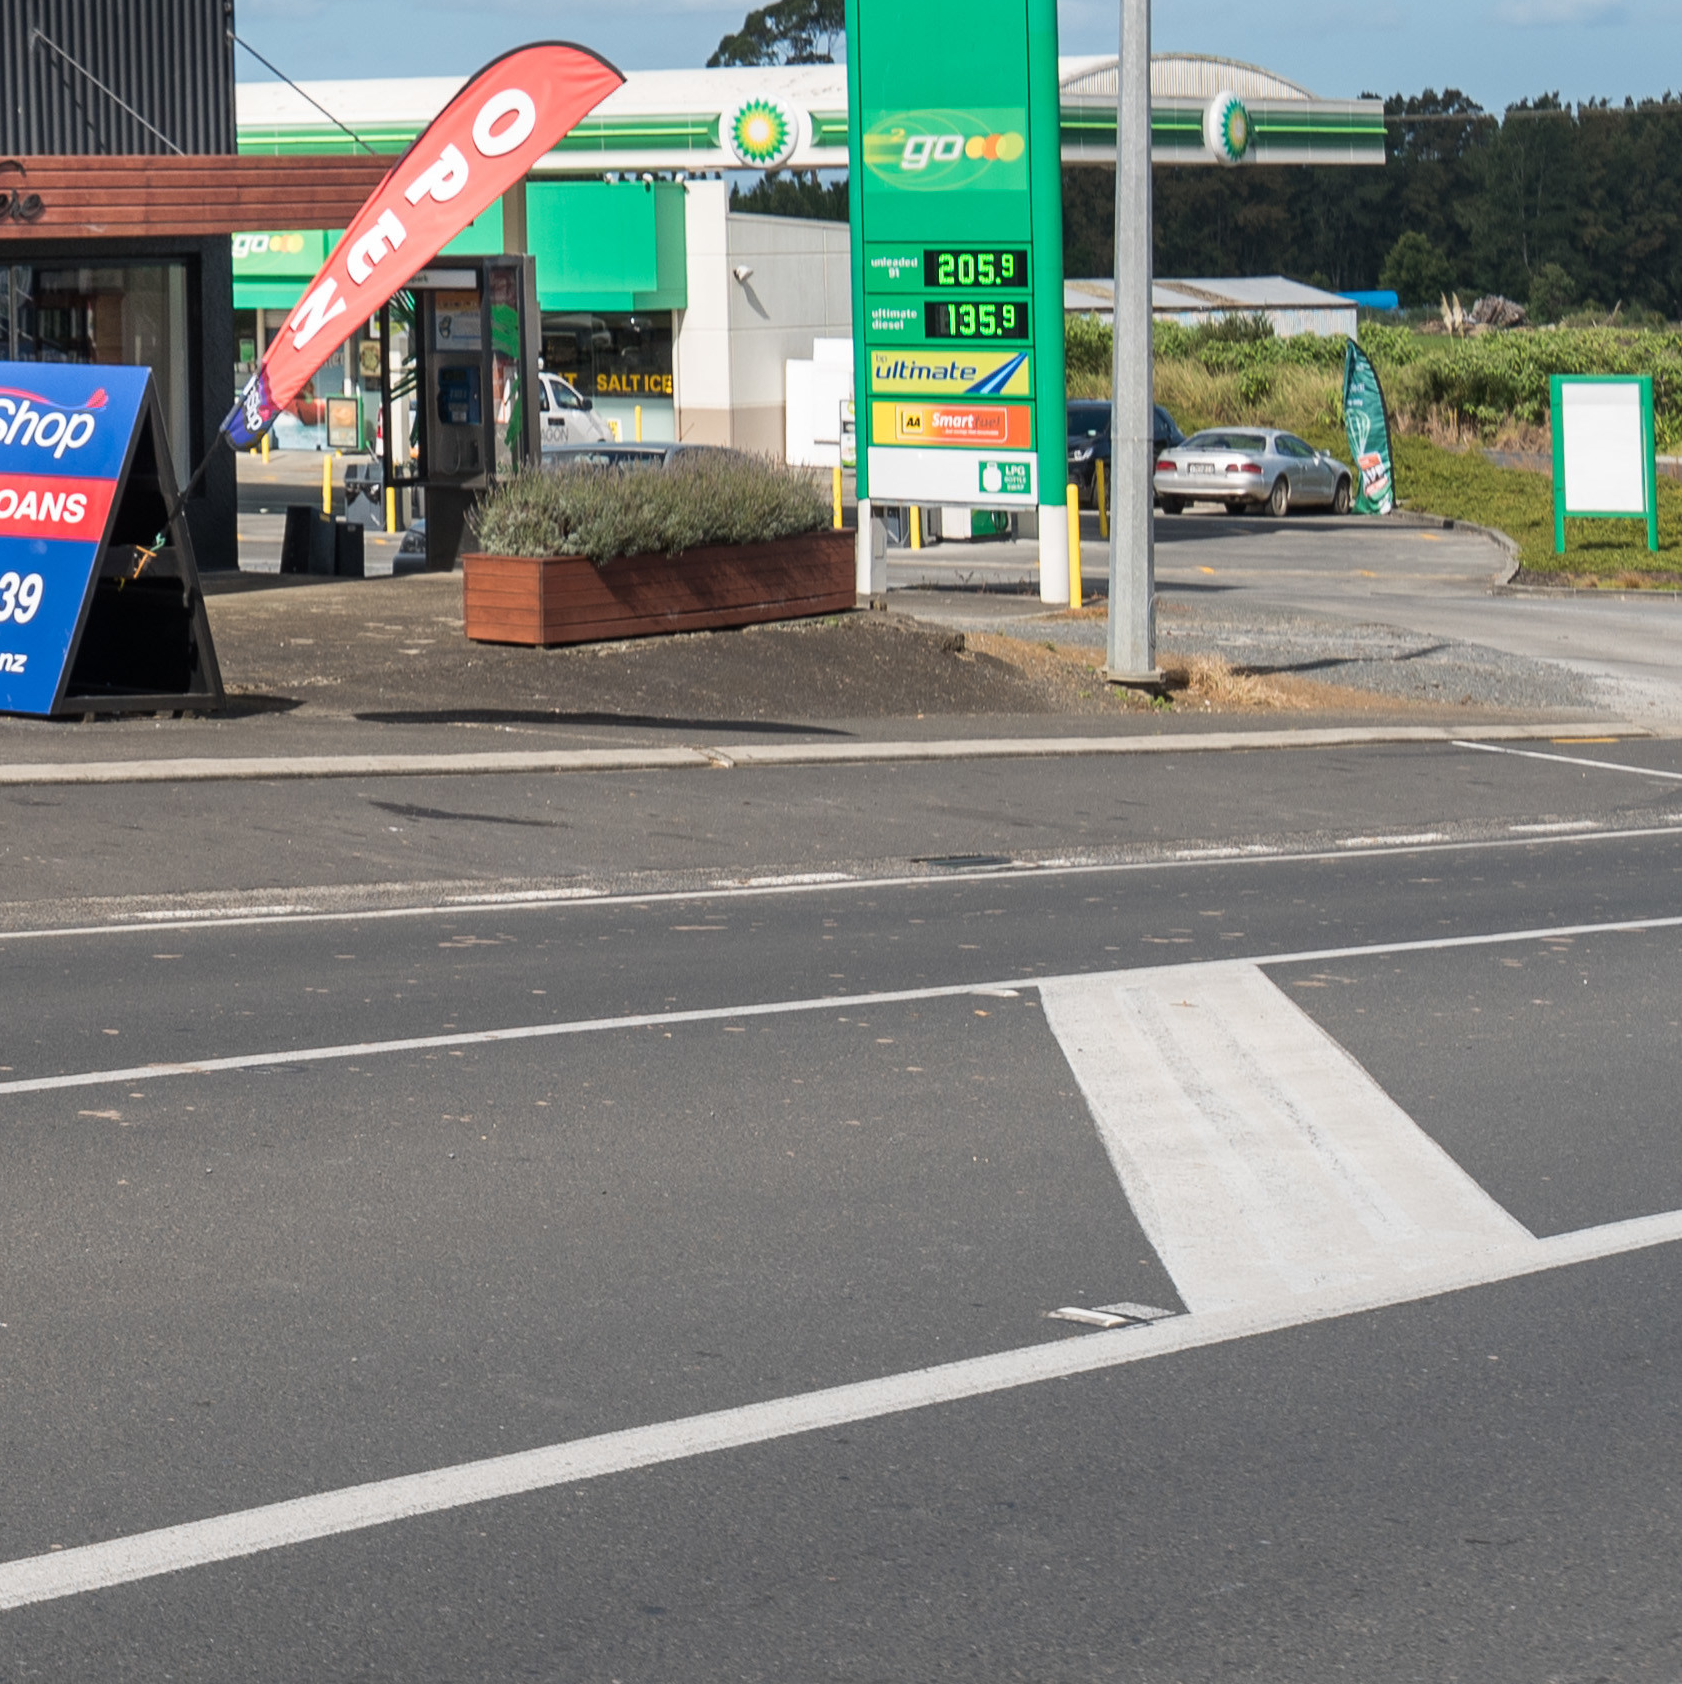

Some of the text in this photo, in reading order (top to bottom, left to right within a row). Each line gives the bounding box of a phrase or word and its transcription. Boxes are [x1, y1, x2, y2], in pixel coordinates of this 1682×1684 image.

[288, 88, 537, 350] OPEN
[870, 256, 918, 269] unleaded
[938, 252, 1014, 285] 205.9
[888, 267, 900, 279] 91
[871, 307, 918, 320] ultimate
[947, 302, 1016, 337] 135.9
[871, 319, 905, 331] diesel
[875, 359, 978, 381] ultimate
[596, 373, 641, 392] SALT
[906, 416, 921, 428] AA
